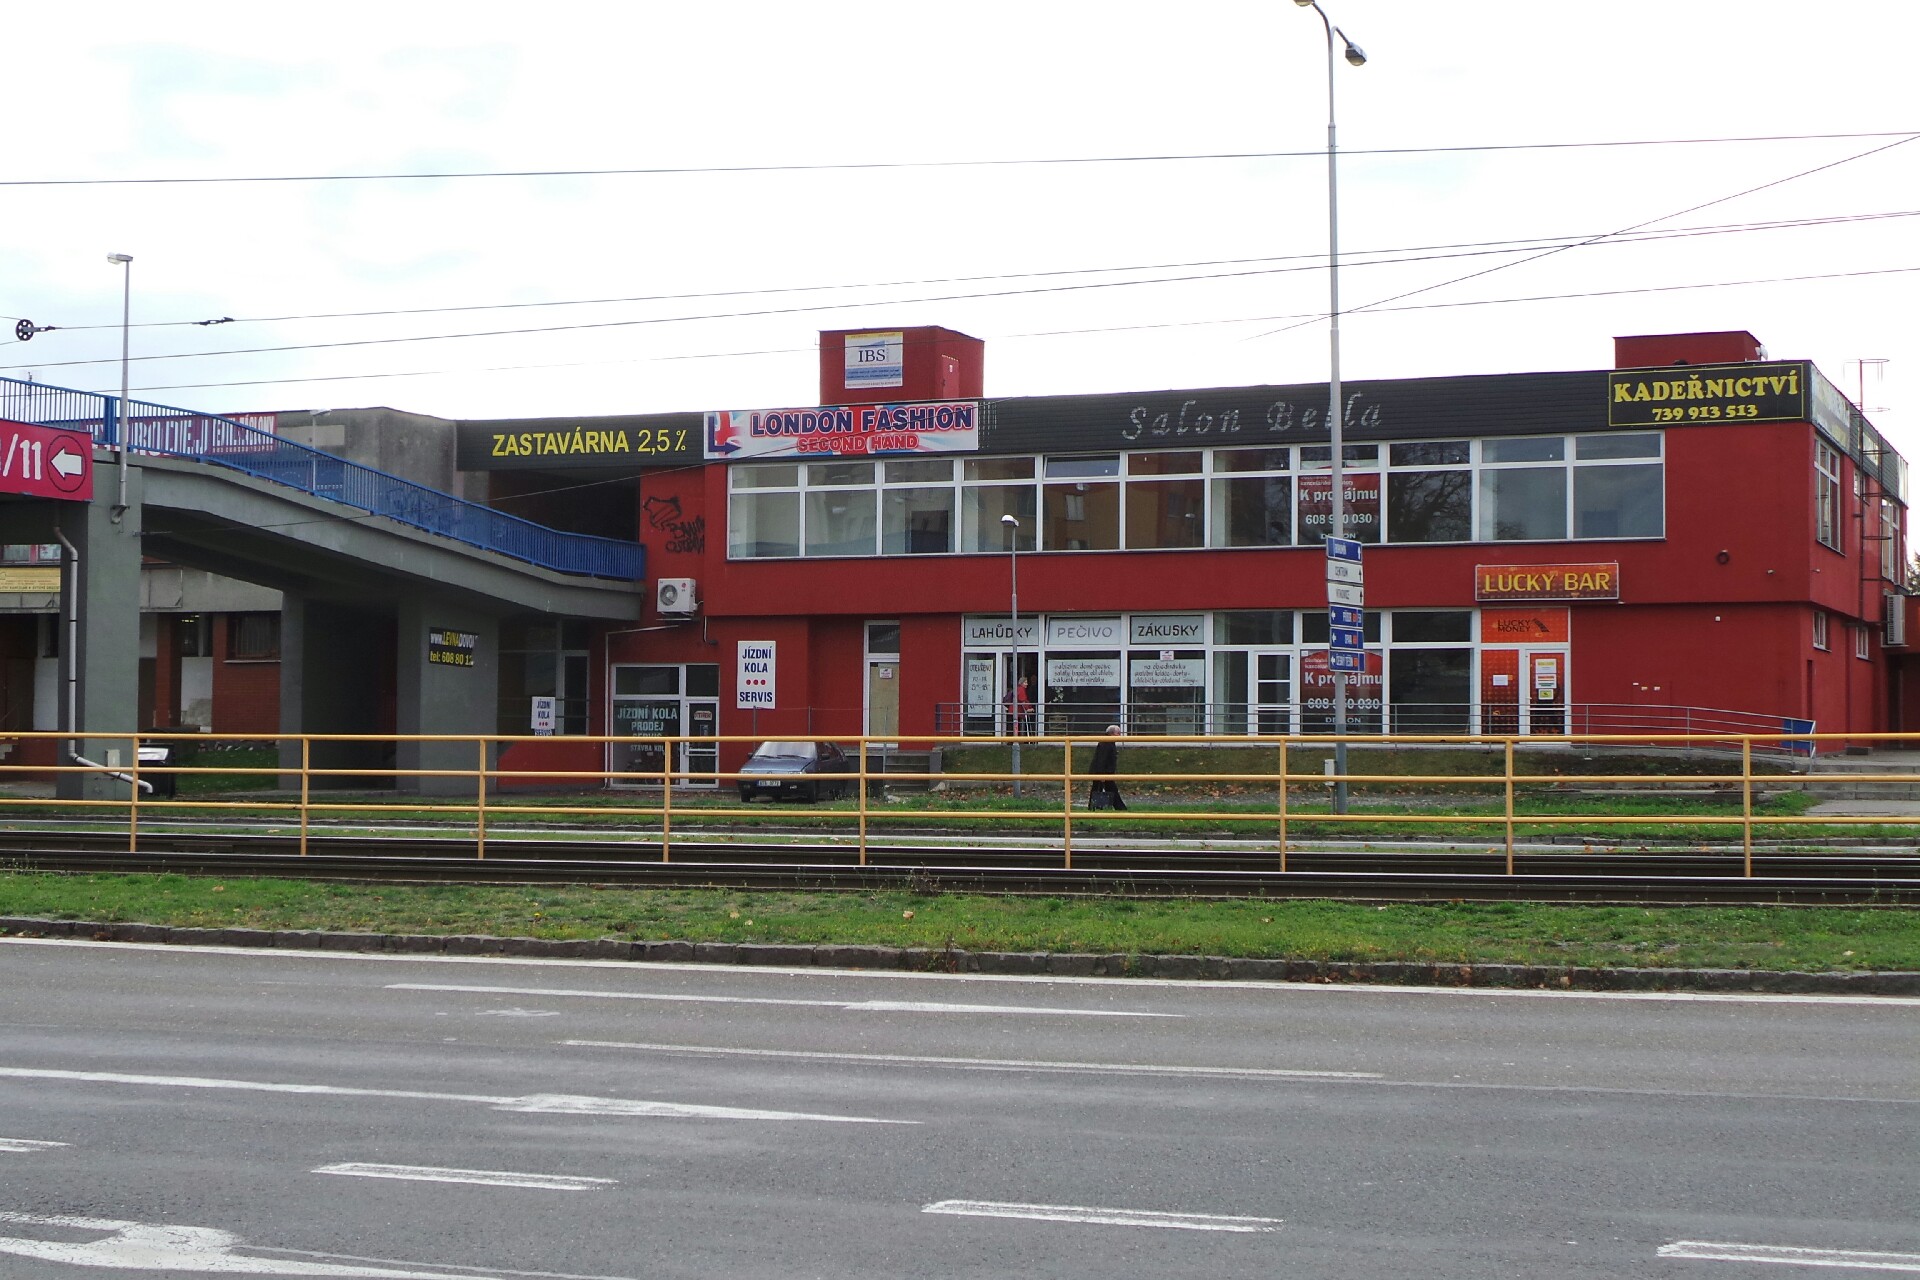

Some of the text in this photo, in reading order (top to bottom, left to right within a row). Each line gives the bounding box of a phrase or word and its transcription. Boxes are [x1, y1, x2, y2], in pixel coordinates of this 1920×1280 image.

[858, 349, 885, 362] IBS
[1614, 370, 1798, 402] KADEŘNICTVÍ
[1652, 404, 1758, 421] 739 913 513
[750, 405, 974, 437] LONDON FASHION
[1121, 400, 1241, 440] Salon
[492, 426, 629, 456] ZASTAVÁRNA
[797, 434, 918, 453] SECOND HAND
[0, 433, 42, 480] /11
[1300, 488, 1378, 503] K proájmu
[1305, 513, 1373, 524] 608 90 030
[1485, 573, 1610, 592] LUCKY BAR
[1497, 619, 1530, 627] LUCKY
[1497, 625, 1530, 633] MONEY
[1057, 625, 1113, 638] PEČIVO
[1138, 624, 1199, 637] ZÁKUSKY
[742, 645, 772, 659] JÍZDNÍ
[744, 662, 768, 673] KOLA
[1305, 671, 1382, 686] K proájmu
[740, 691, 773, 702] SERVIS
[1307, 698, 1329, 709] 608
[1357, 699, 1380, 709] 030
[538, 711, 550, 719] KOLA
[617, 705, 678, 719] JÍZDNÍ KOLA
[631, 721, 664, 731] PRODEJ
